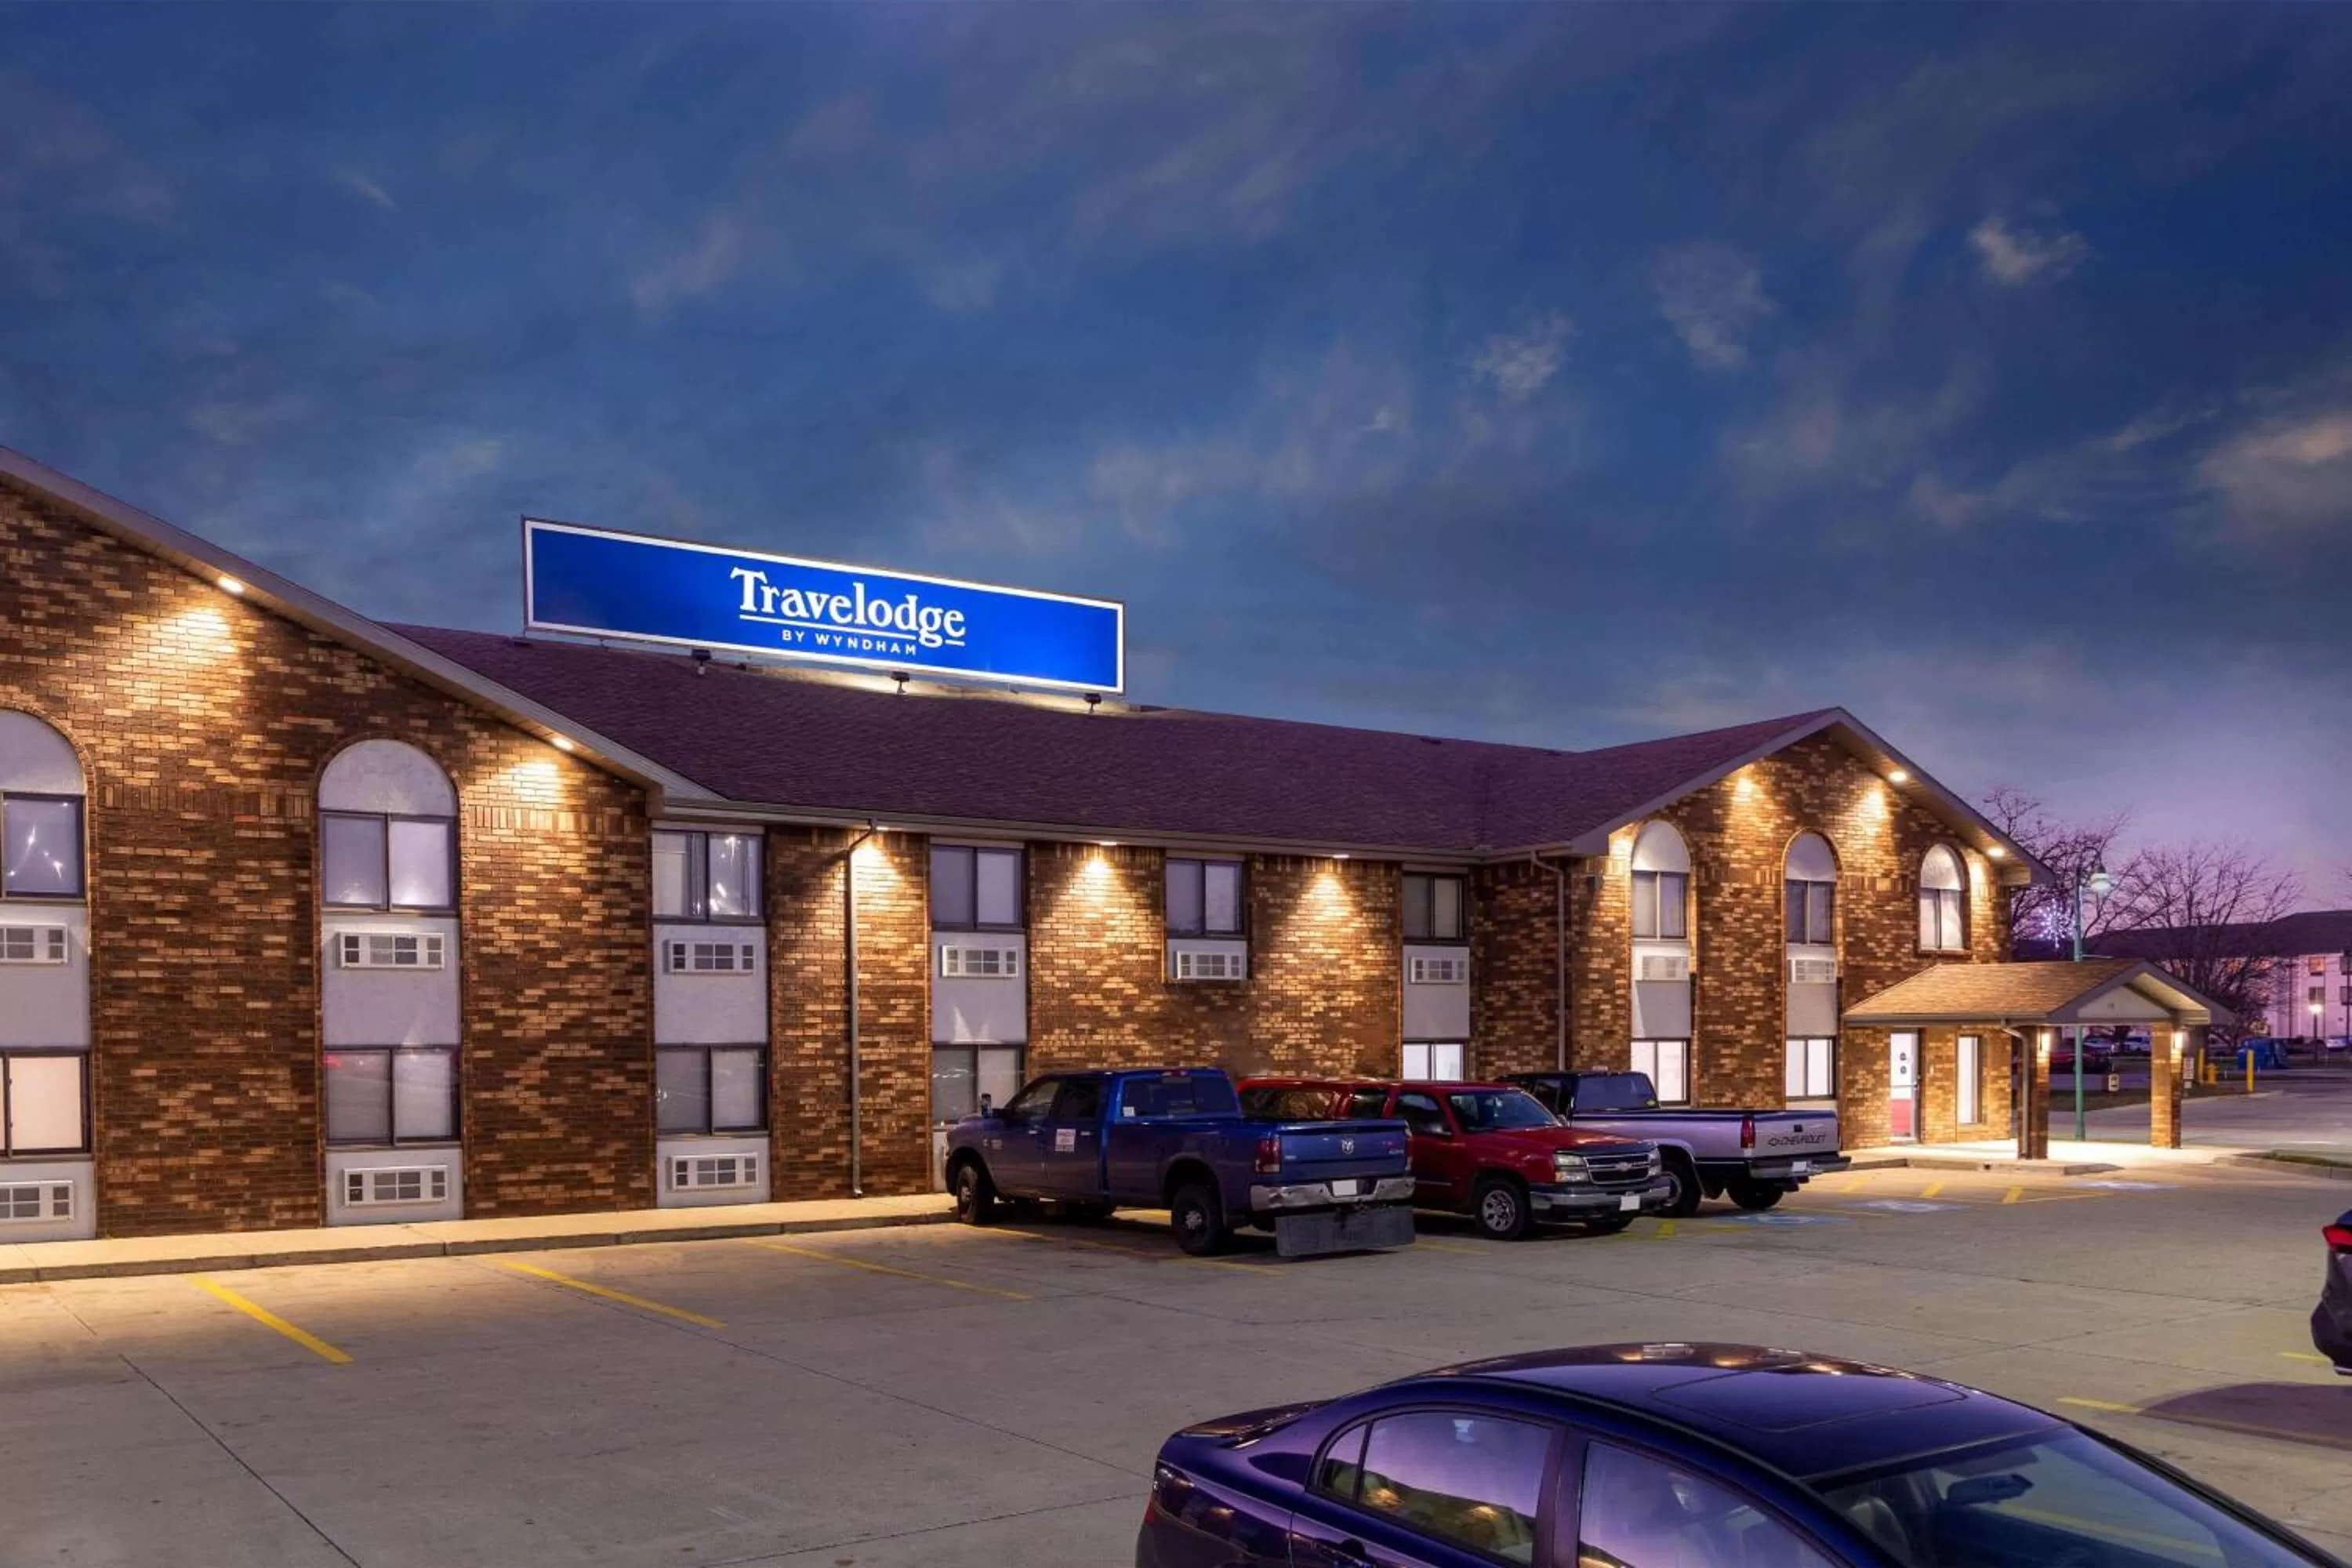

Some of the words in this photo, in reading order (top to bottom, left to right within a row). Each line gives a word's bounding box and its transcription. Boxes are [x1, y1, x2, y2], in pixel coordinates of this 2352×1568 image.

[730, 567, 966, 648] Travelodge
[782, 630, 804, 642] BY
[815, 633, 916, 655] WYNDHAM
